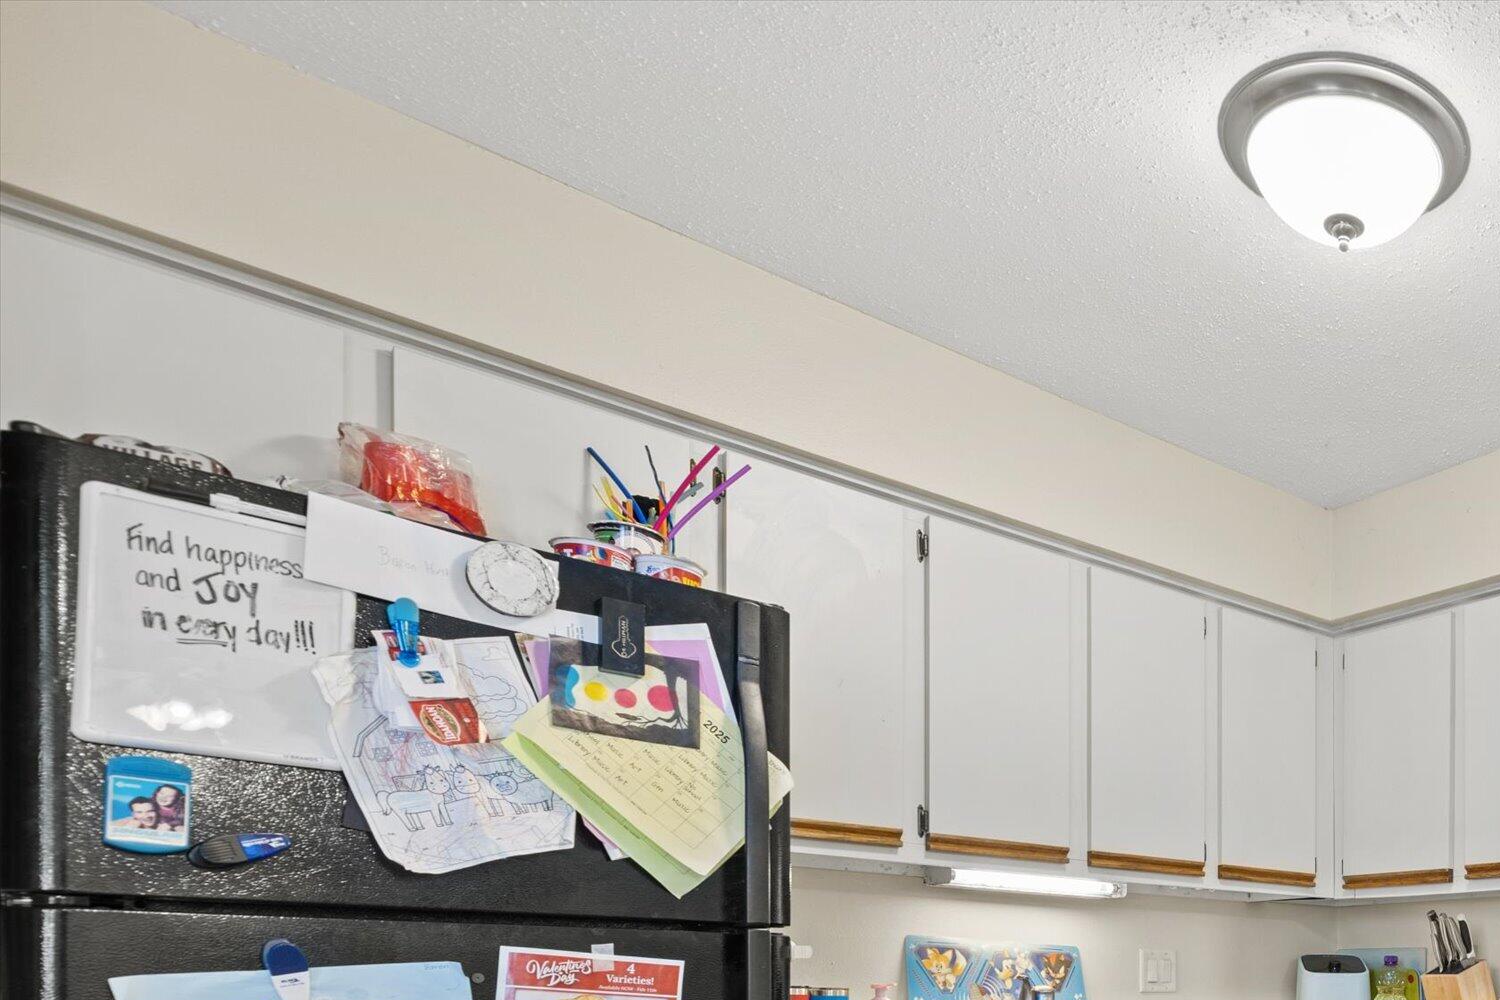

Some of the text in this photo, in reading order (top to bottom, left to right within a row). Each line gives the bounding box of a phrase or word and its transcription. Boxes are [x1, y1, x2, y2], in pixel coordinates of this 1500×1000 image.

[126, 523, 304, 580] Find happiness
[136, 568, 181, 592] and
[141, 607, 167, 632] in
[246, 619, 316, 655] day!!!
[703, 720, 731, 744] 2025
[547, 971, 579, 987] Day
[606, 974, 654, 985] Varieties!
[627, 964, 636, 974] 4
